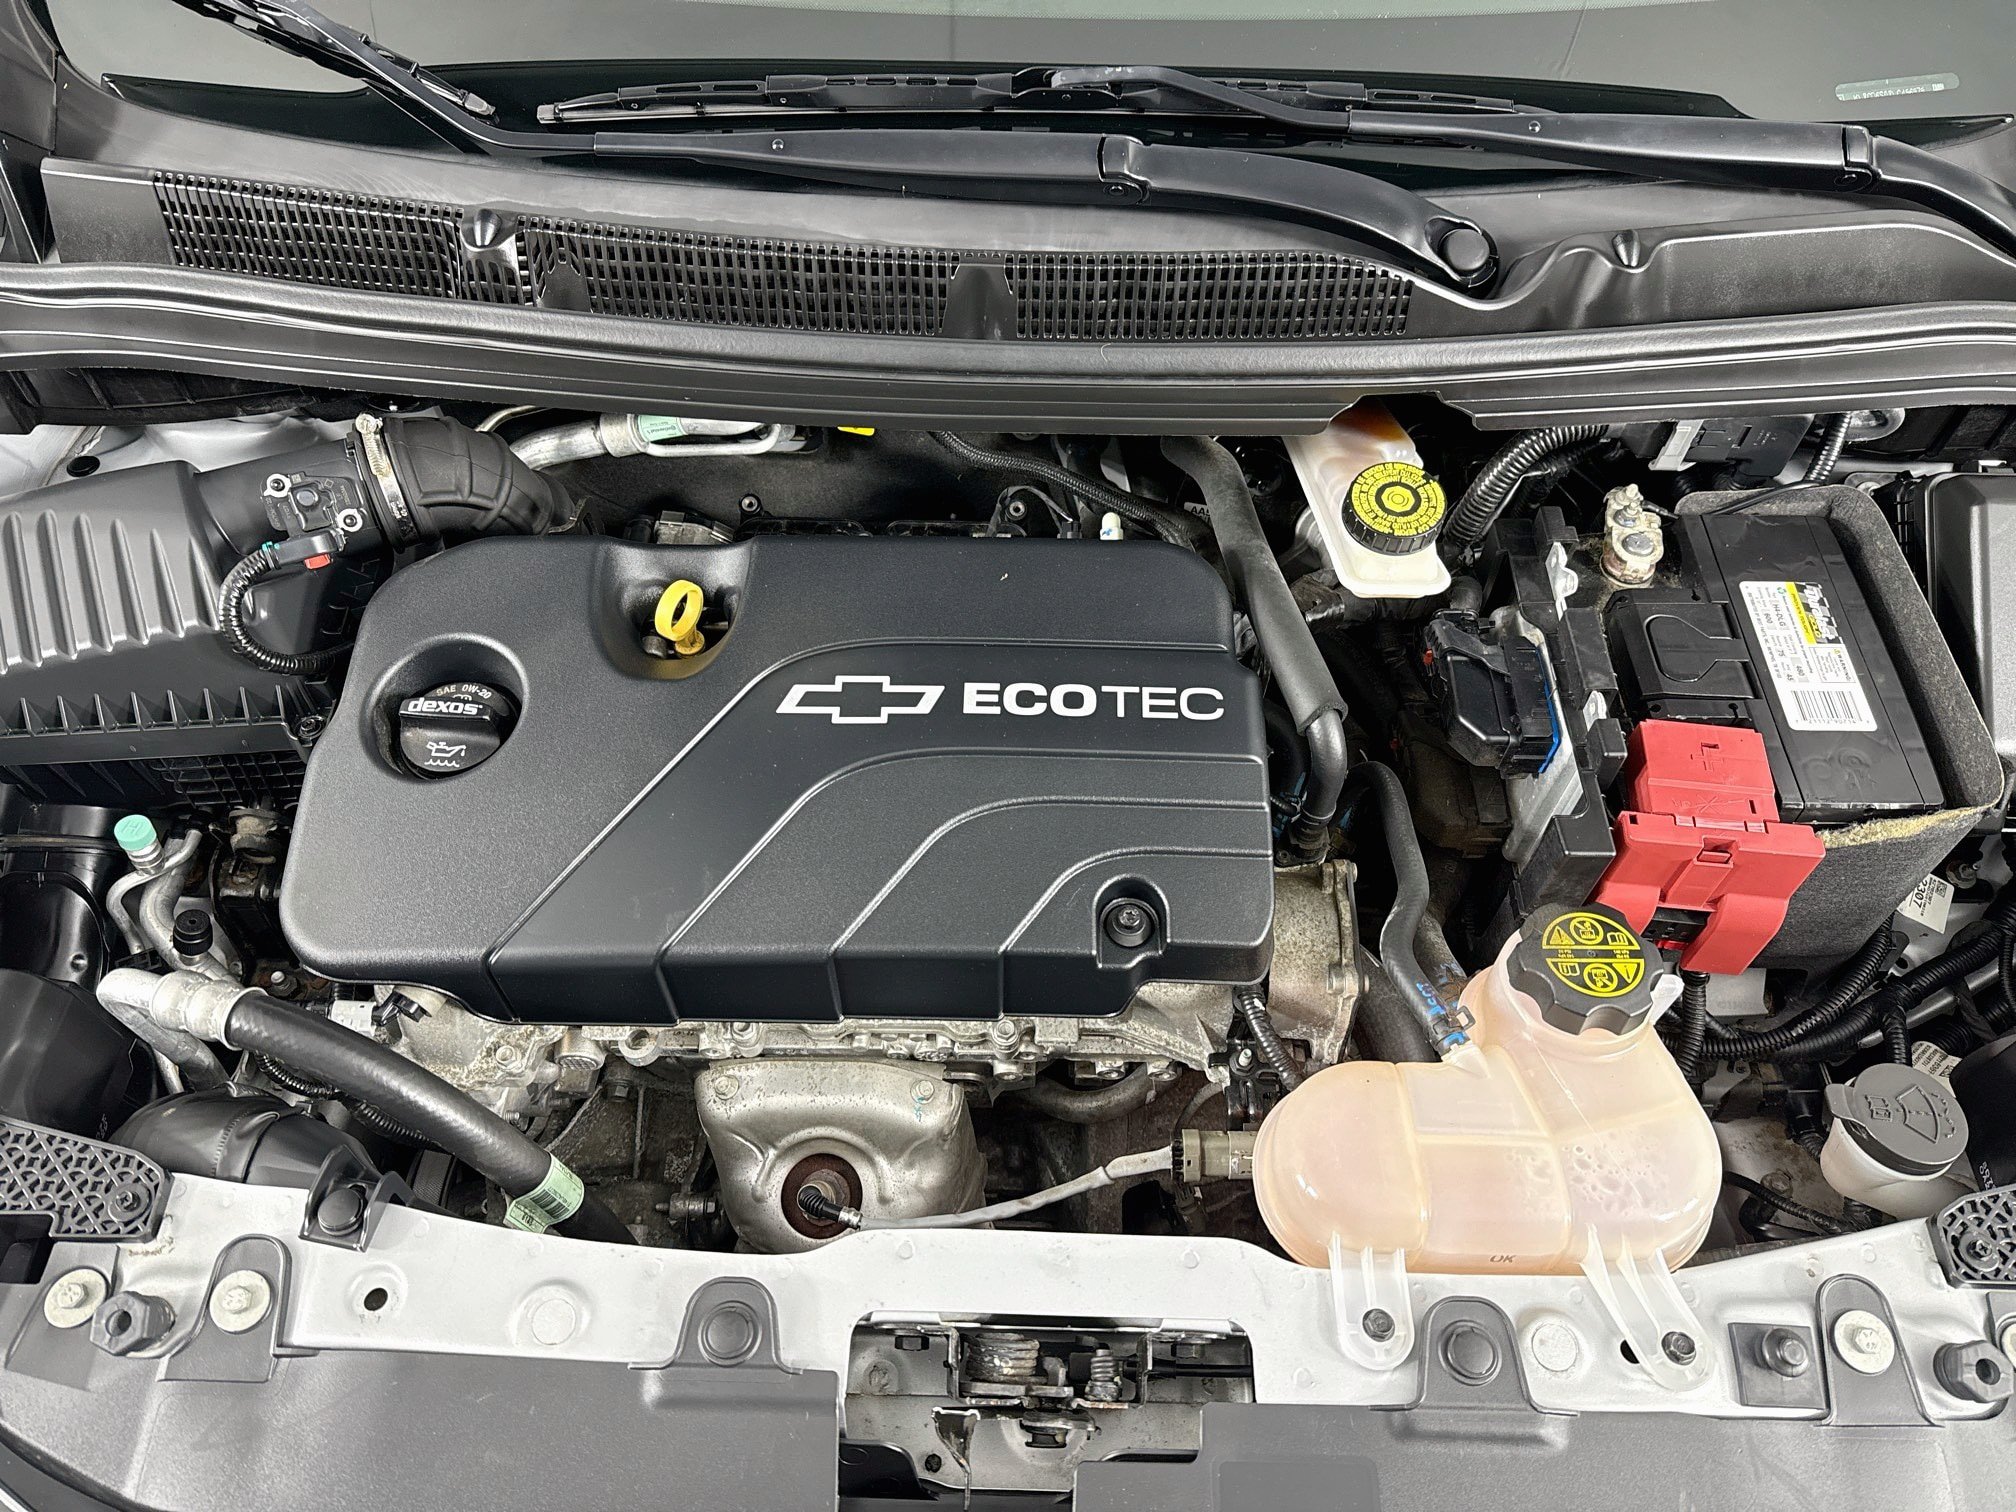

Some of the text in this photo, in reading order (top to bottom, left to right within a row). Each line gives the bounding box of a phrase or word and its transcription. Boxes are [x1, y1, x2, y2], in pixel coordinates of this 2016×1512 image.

[437, 684, 491, 699] SAE 0W-20
[962, 682, 1226, 721] ECOTEC
